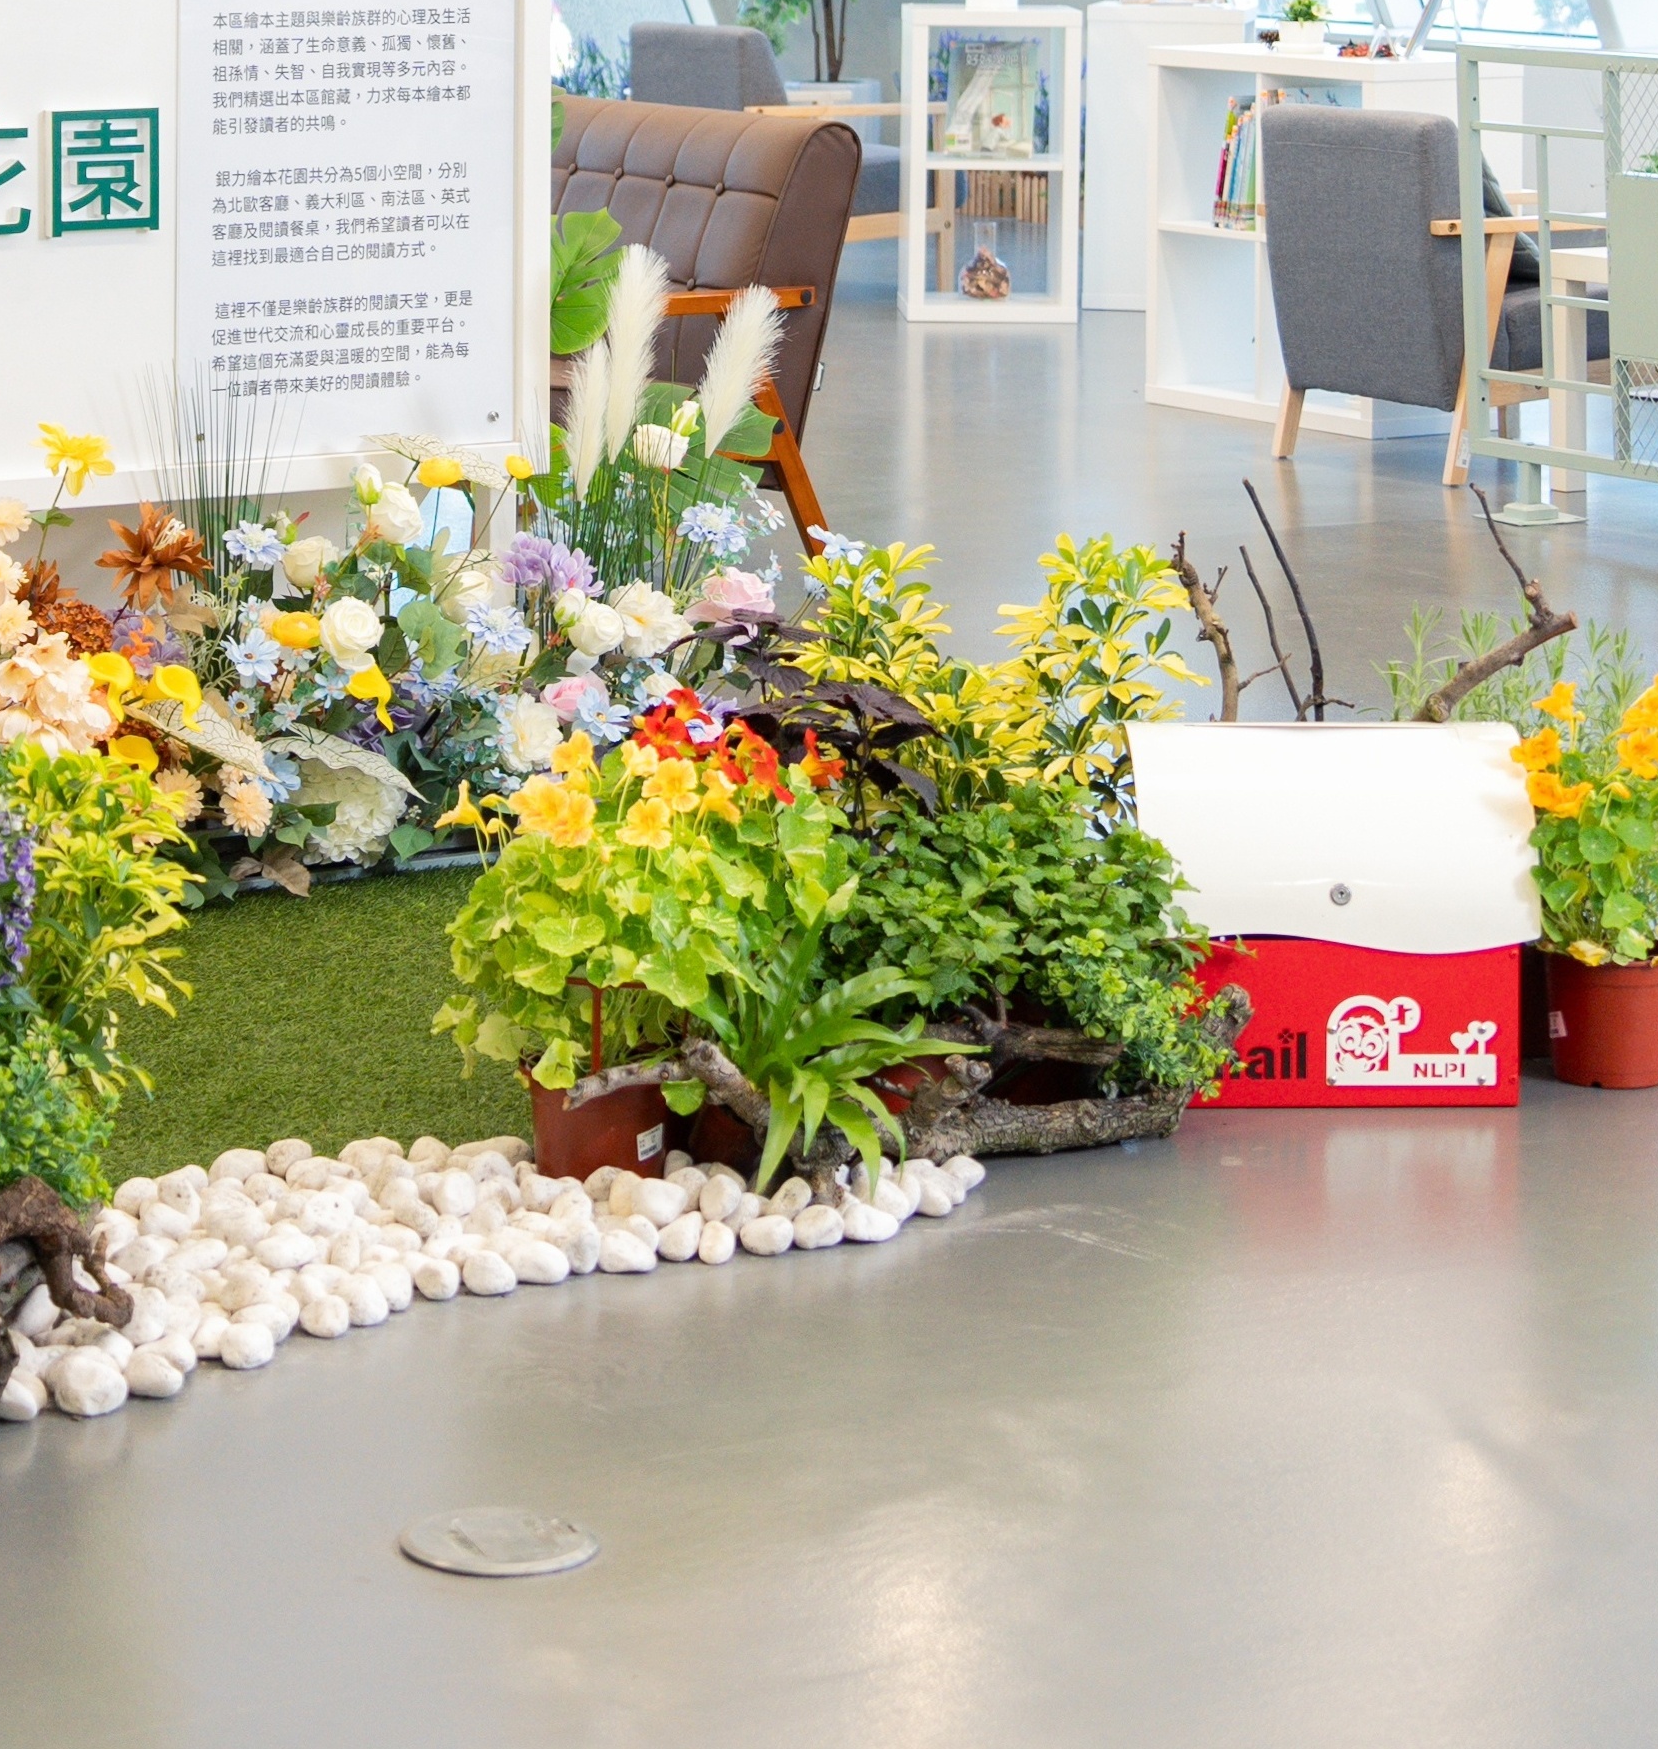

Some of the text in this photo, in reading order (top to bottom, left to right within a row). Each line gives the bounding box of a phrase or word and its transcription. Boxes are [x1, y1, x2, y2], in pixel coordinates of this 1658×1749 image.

[213, 7, 471, 30] 本區繪本主題與樂齡族群的心理及生活
[213, 34, 468, 56] 相關，涵蓋了生命意義、孤獨、懷舊、
[213, 60, 468, 82] 祖孫情、失智、自我實現等多元內容。
[213, 84, 471, 108] 我們精選出本區館藏，力求每本繪本都
[213, 116, 348, 136] 能引發讀者的共鳴。
[215, 162, 467, 187] 銀力繪本花園共分為5個小空間，分別
[213, 187, 470, 215] 為北歐客廳、義大利區、南法區、英式
[213, 213, 470, 241] 客廳及閱讀餐桌，我們希望讀者可以在
[212, 242, 436, 267] 這裡找到最適合自己的閱讀方式。
[215, 290, 472, 320] 這裡不僅是樂齡族群的閱讀天堂，更是
[212, 316, 467, 347] 促進世代交流和心靈成長的重要平台。
[211, 342, 469, 373] 希望這個充滿愛與溫暖的空間，能為每
[1413, 1062, 1467, 1080] NLPI
